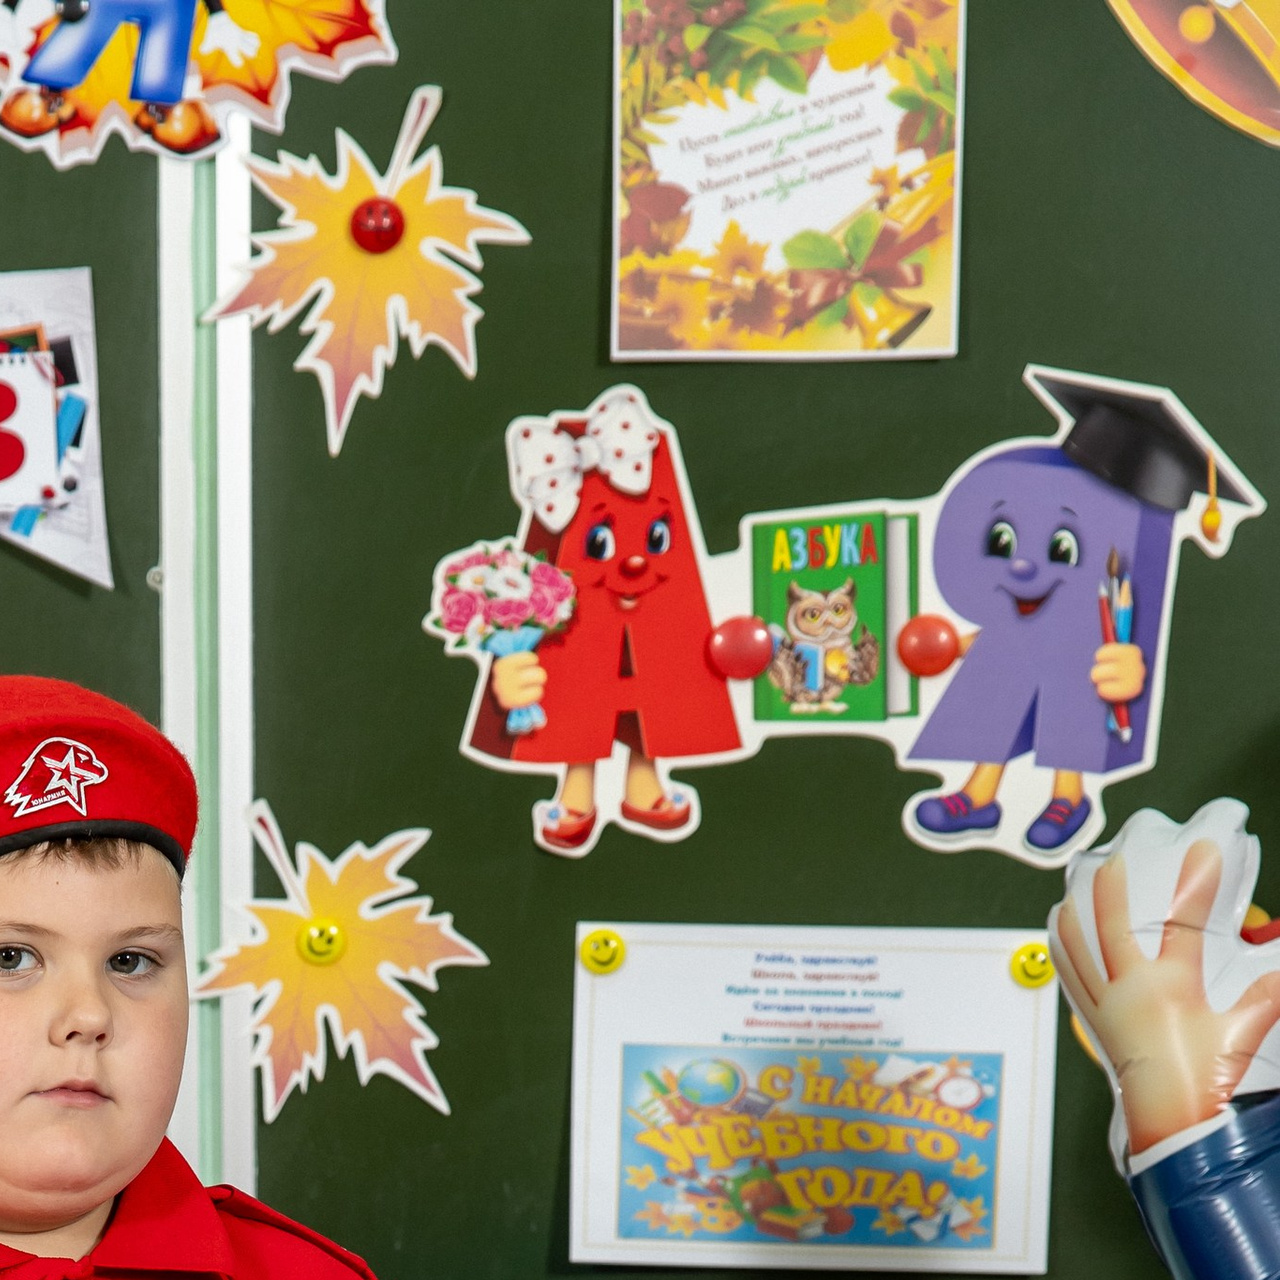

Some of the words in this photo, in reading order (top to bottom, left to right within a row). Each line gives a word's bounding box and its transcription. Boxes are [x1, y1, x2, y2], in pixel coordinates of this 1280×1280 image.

[772, 522, 878, 573] АЗБУКА
[31, 790, 66, 806] ЮНАРМИЯ
[758, 1065, 793, 1100] С
[801, 1075, 994, 1139] НАЧАЛОМ
[635, 1112, 961, 1174] УЧЕБНОГО
[775, 1166, 949, 1219] ГОДА!
